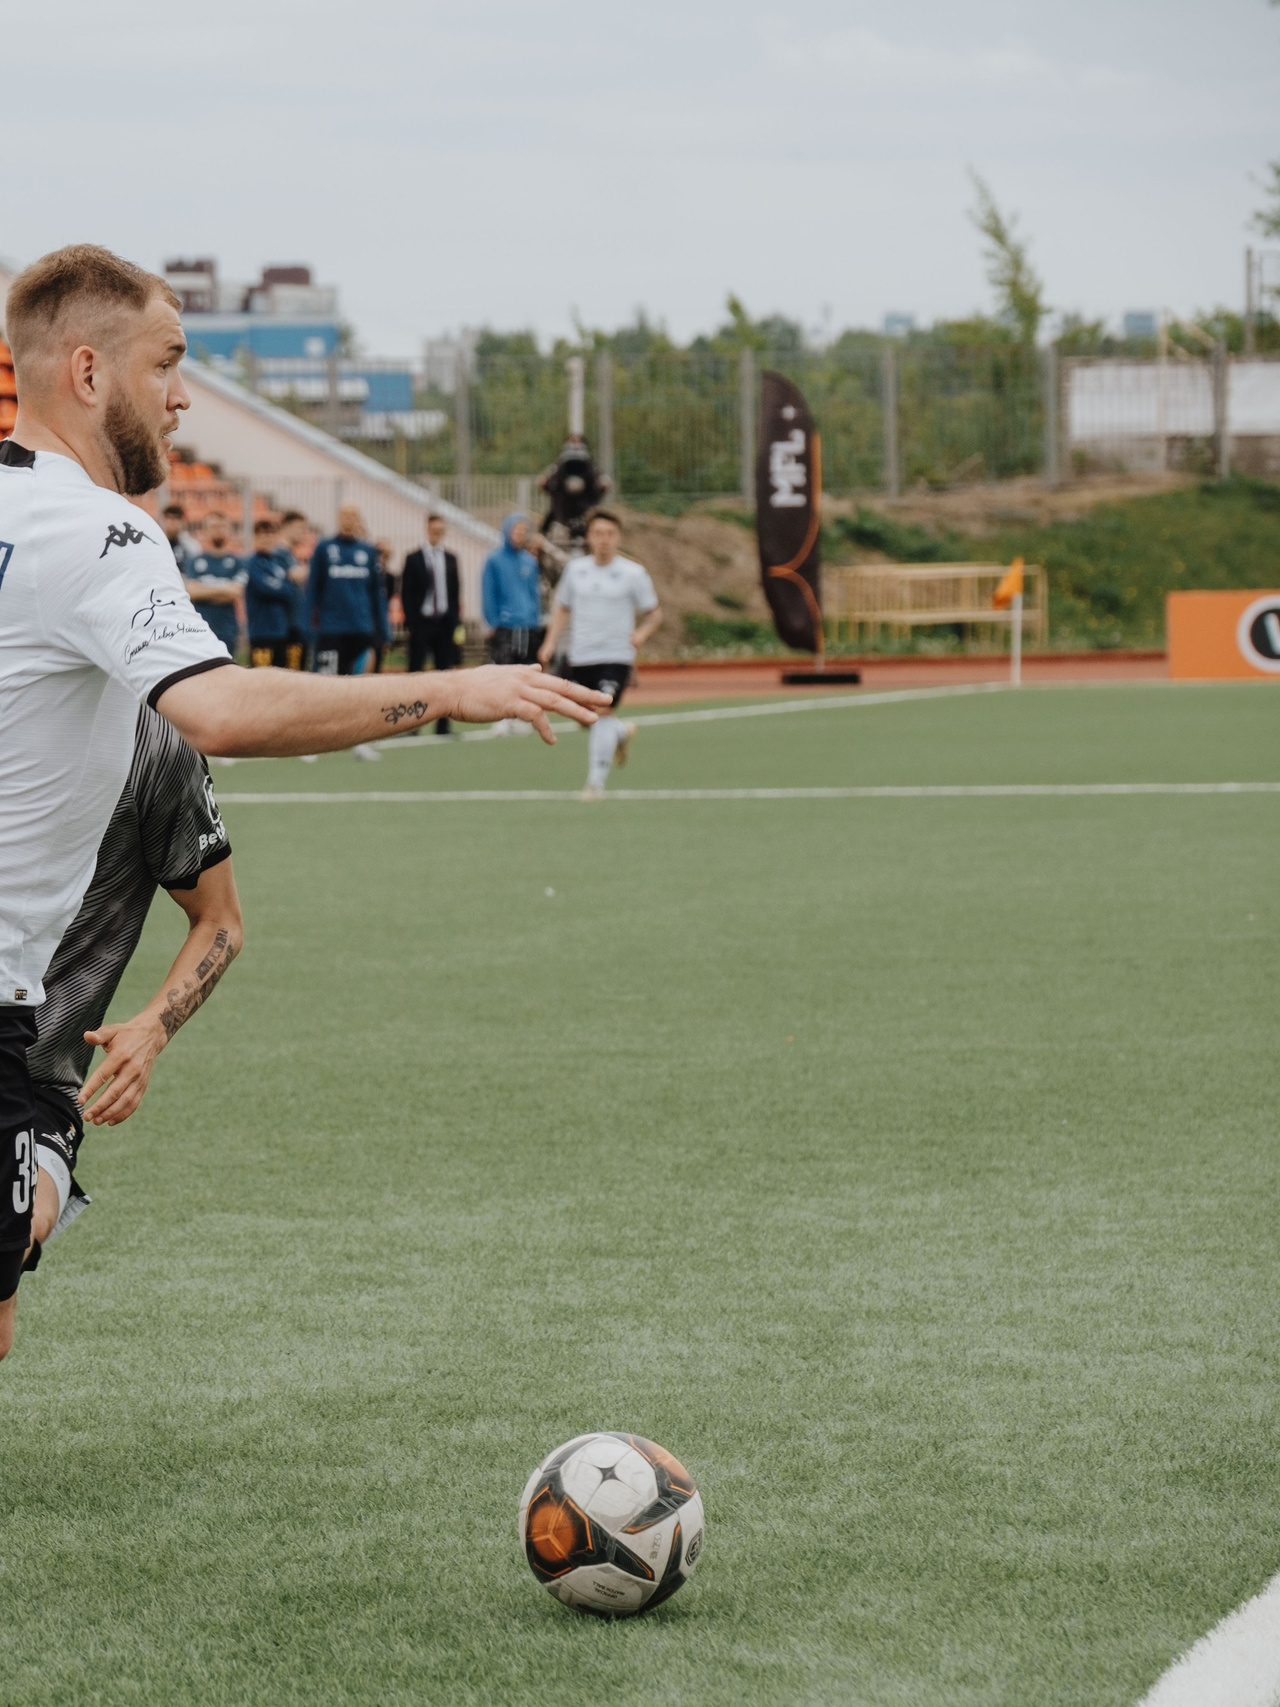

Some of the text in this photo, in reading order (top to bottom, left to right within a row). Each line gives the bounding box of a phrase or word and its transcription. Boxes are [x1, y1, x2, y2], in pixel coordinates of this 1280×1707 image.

[770, 428, 807, 508] MFL
[592, 1580, 626, 1597] MATCH BALL
